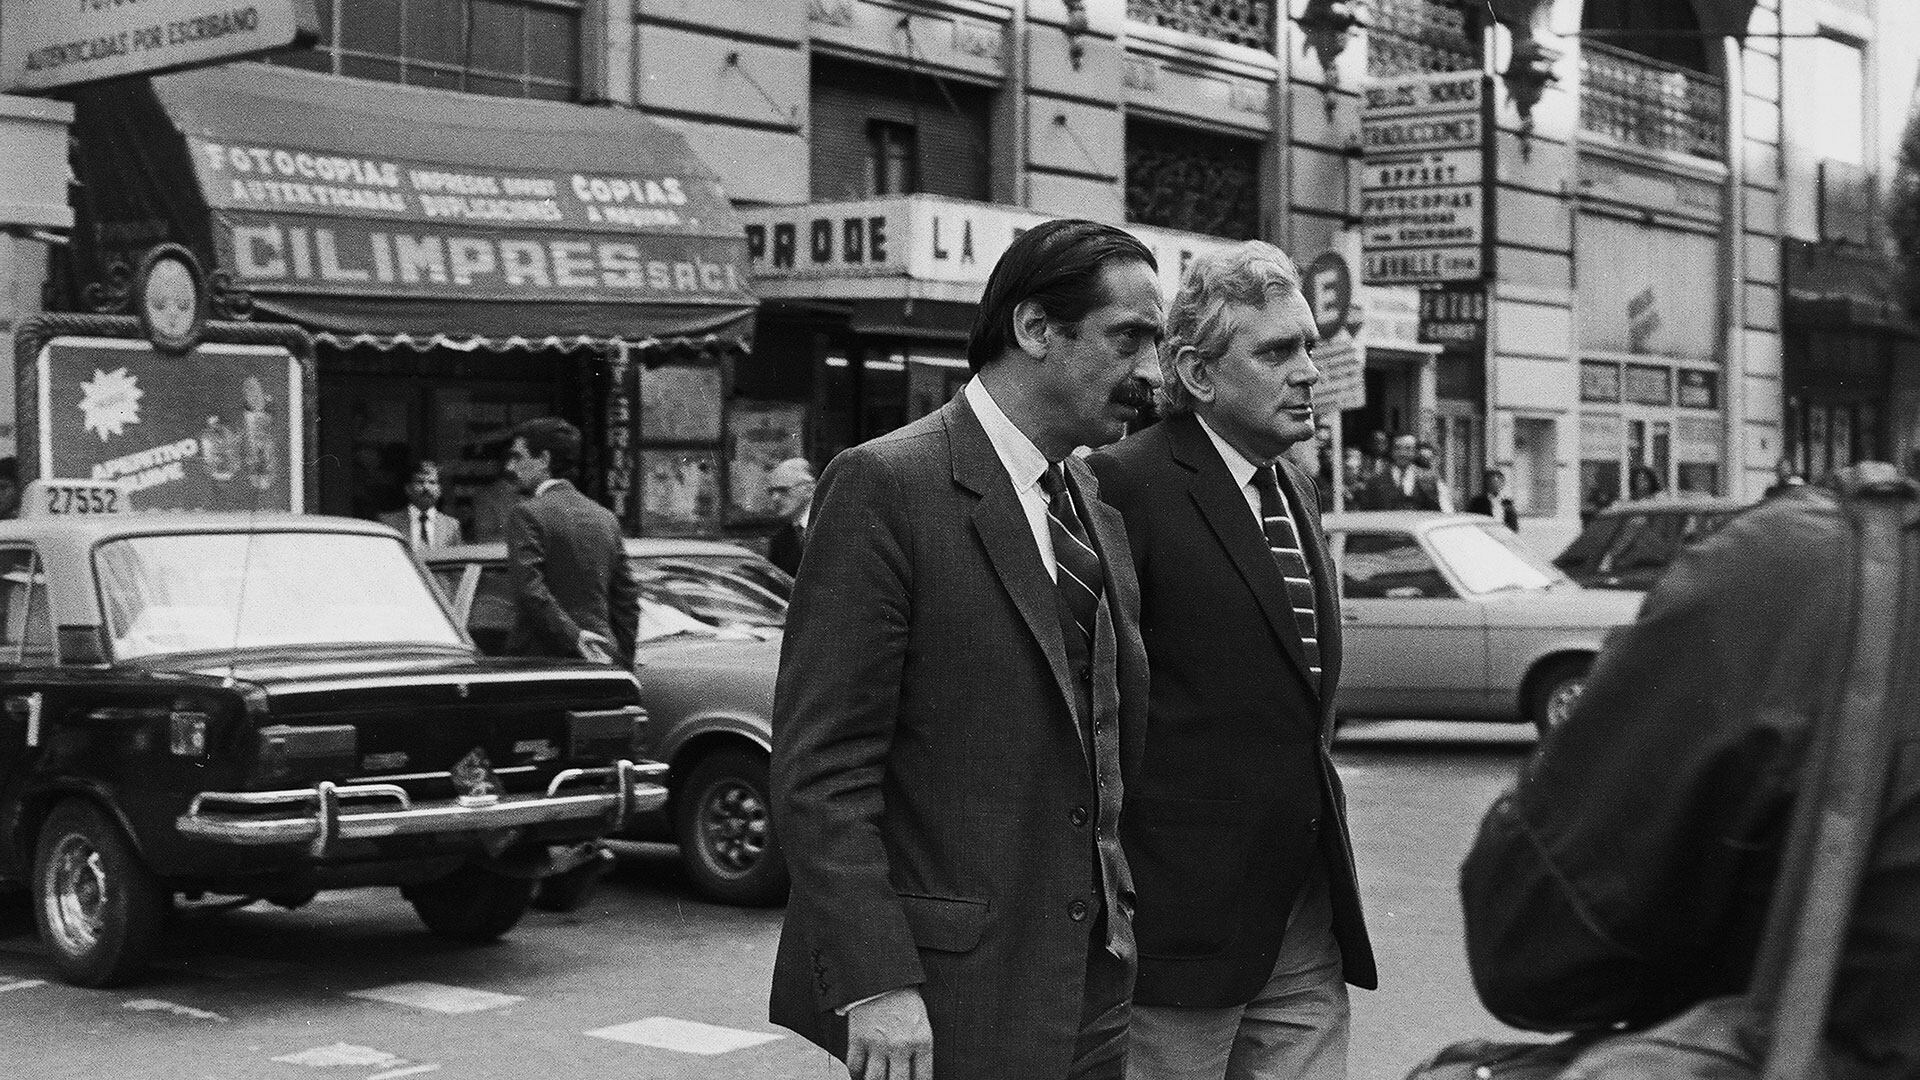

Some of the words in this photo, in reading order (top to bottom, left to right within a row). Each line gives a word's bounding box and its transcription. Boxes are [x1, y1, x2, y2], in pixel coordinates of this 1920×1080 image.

[132, 25, 163, 49] POR
[168, 7, 259, 46] ESCRIBANO
[204, 143, 399, 188] FOTOCOPIAS
[571, 173, 688, 206] COPIAS
[744, 215, 888, 268] PRODE
[931, 214, 976, 264] LA
[1313, 268, 1340, 326] E
[48, 487, 118, 514] 27552
